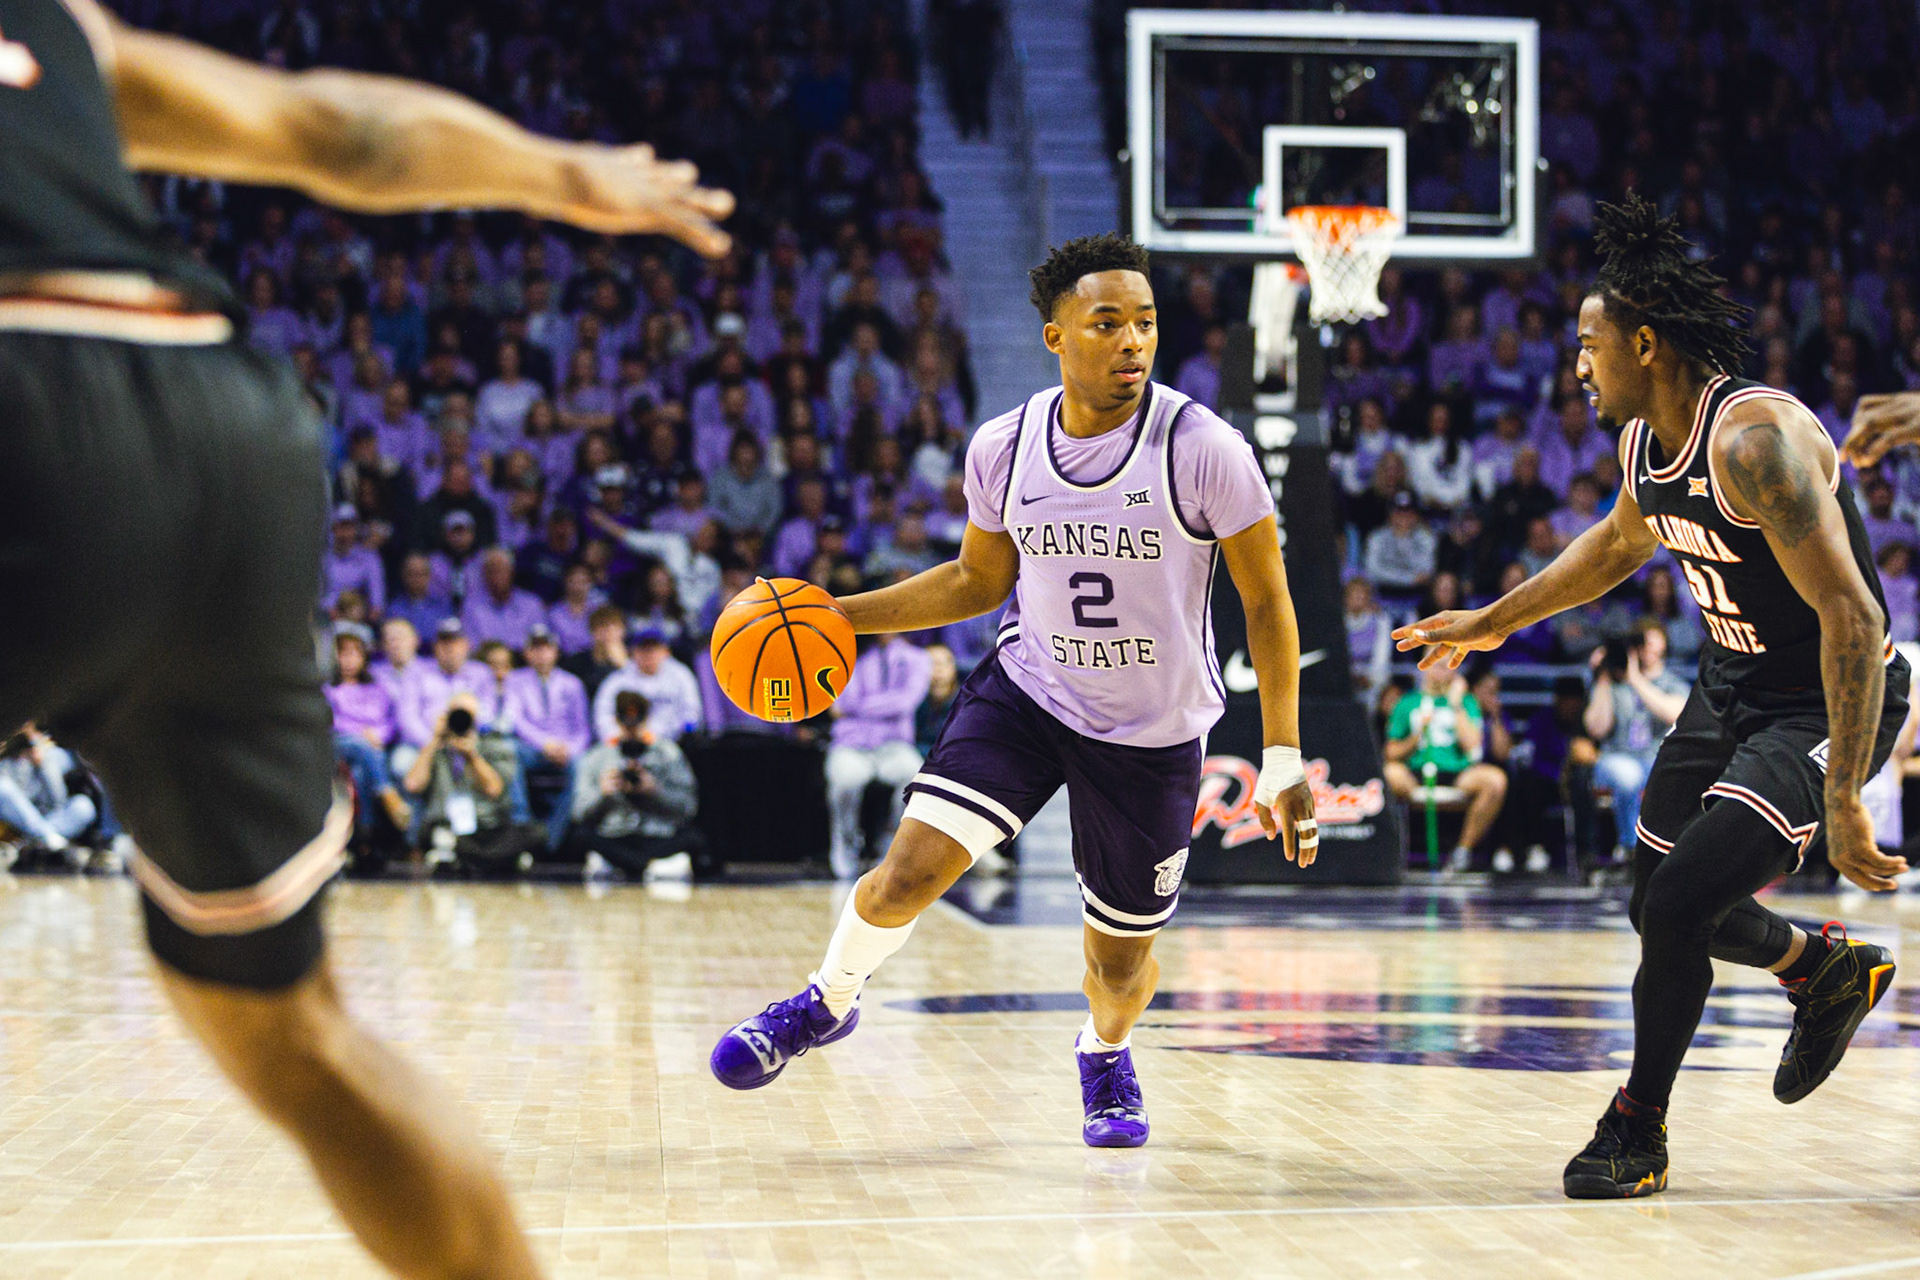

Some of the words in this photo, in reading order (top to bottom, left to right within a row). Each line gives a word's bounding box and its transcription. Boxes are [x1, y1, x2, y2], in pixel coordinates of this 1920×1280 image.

[1016, 522, 1162, 561] KANSAS
[1068, 571, 1119, 628] 2
[1681, 559, 1742, 615] 51
[1051, 633, 1157, 669] STATE
[1700, 608, 1767, 655] STATE
